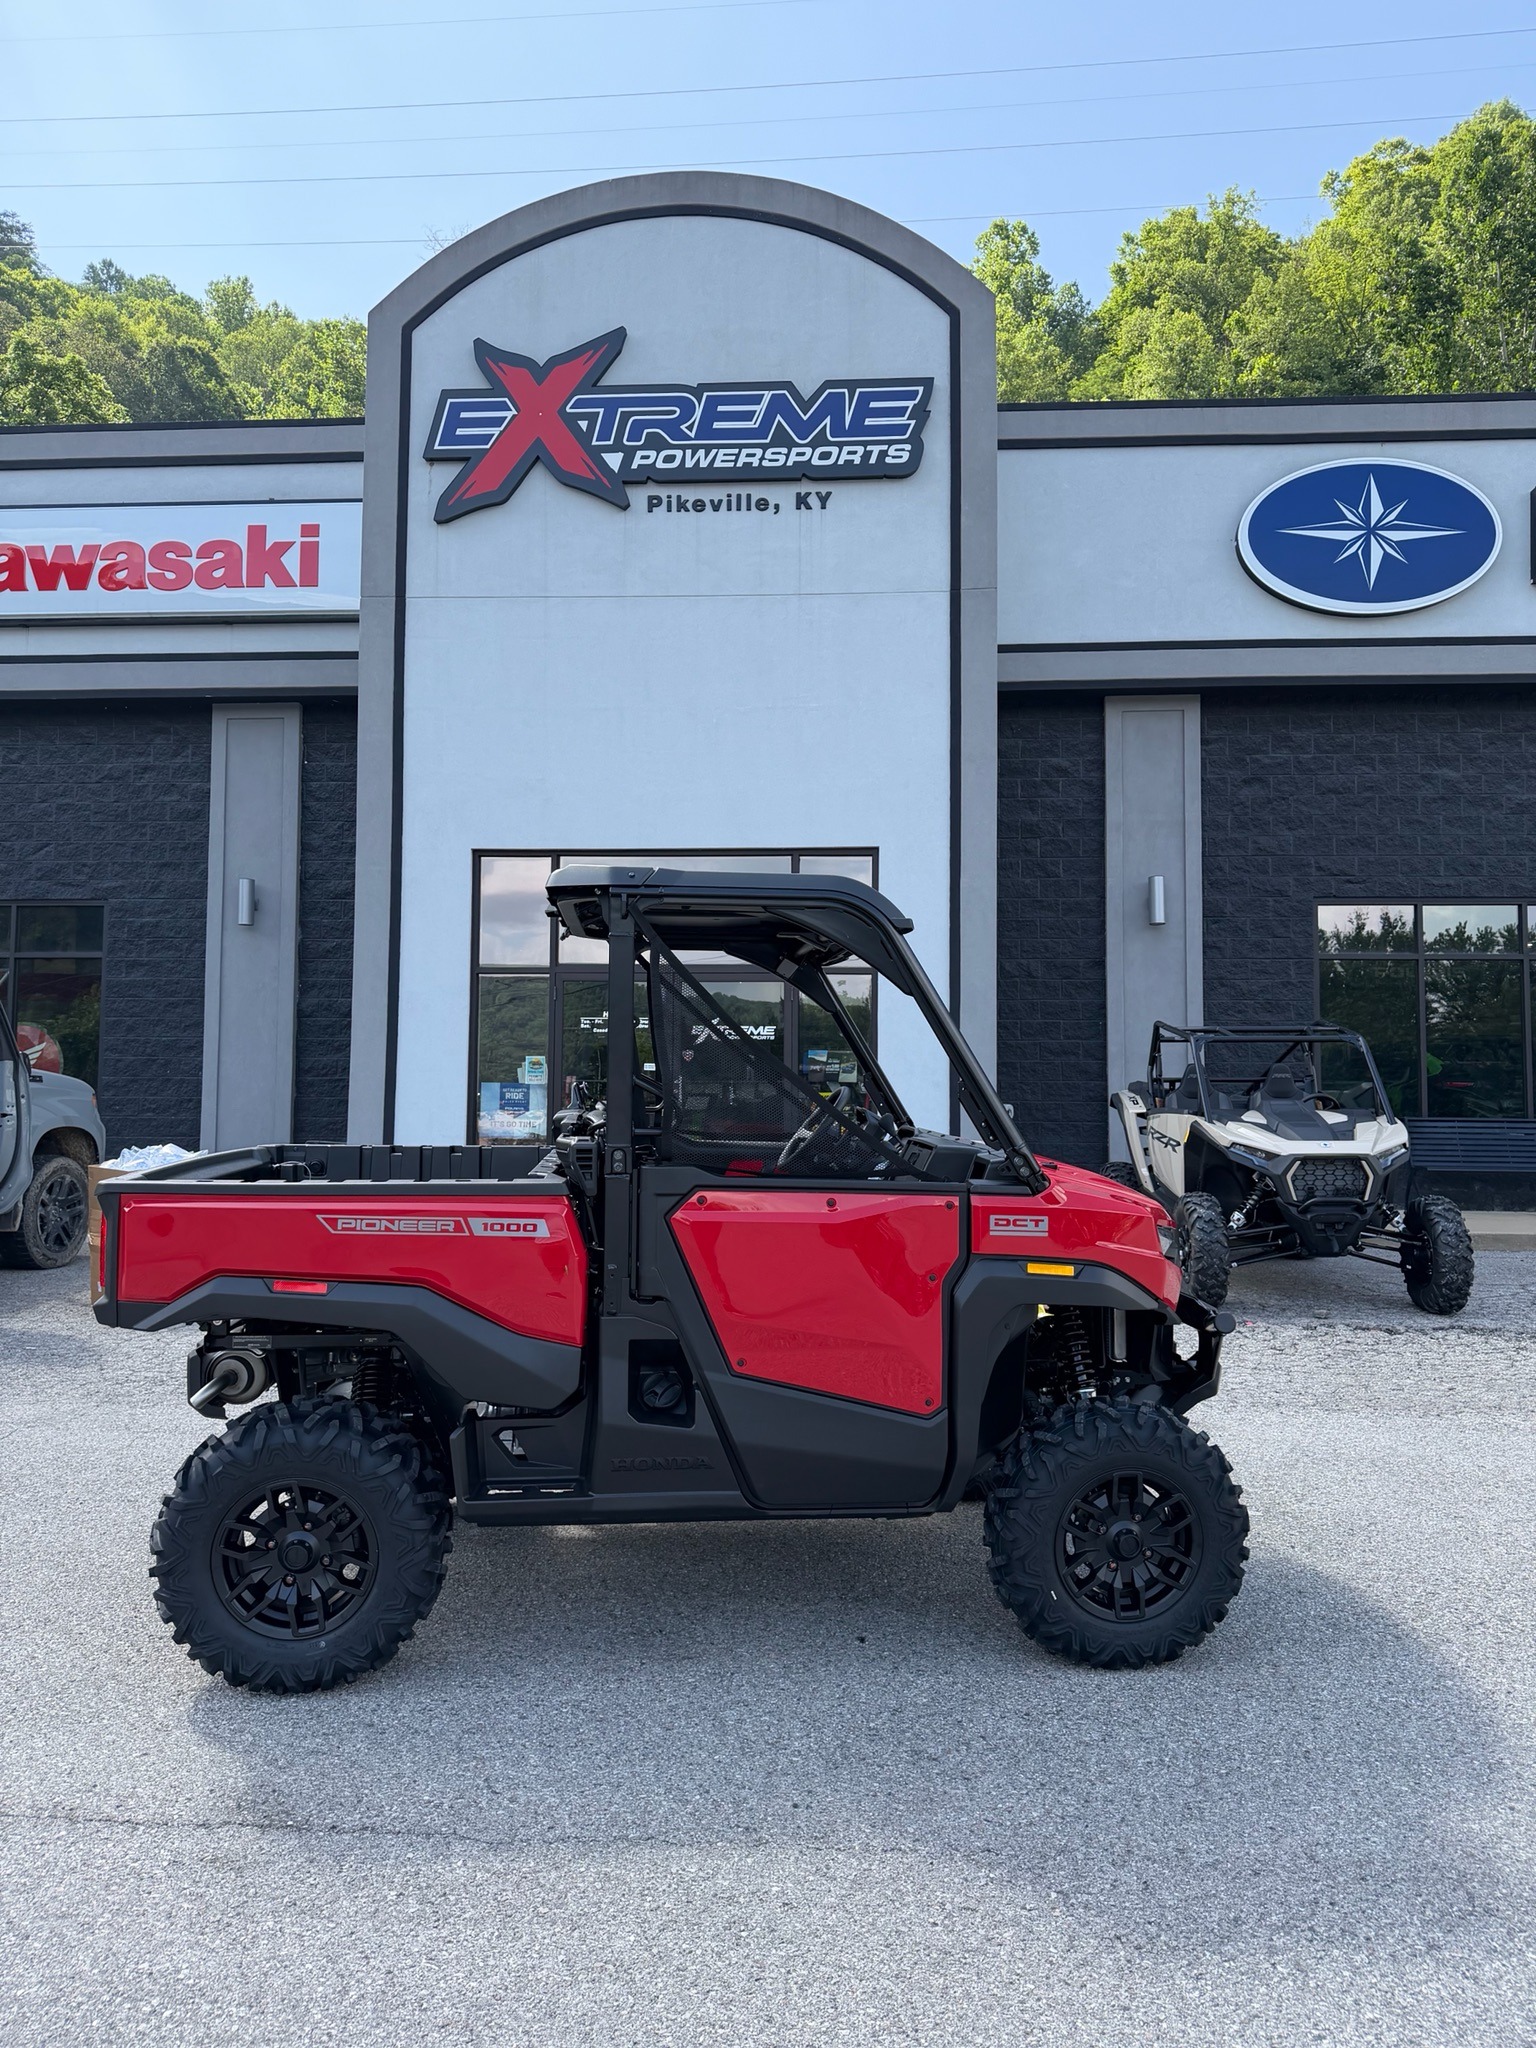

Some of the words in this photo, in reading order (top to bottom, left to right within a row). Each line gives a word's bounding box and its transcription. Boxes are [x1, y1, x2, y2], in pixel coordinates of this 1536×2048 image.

[433, 342, 925, 507] EXTREME
[630, 444, 911, 470] POWERSPORTS
[646, 494, 781, 515] Pikeville,
[795, 490, 833, 511] KY
[505, 1092, 525, 1100] RIDE
[506, 1120, 517, 1128] GO
[517, 1120, 537, 1128] TIME
[1147, 1126, 1182, 1154] RZR
[336, 1218, 455, 1232] PIONEER
[481, 1222, 538, 1233] 1000
[994, 1218, 1045, 1228] DCT
[610, 1456, 715, 1473] HONDA
